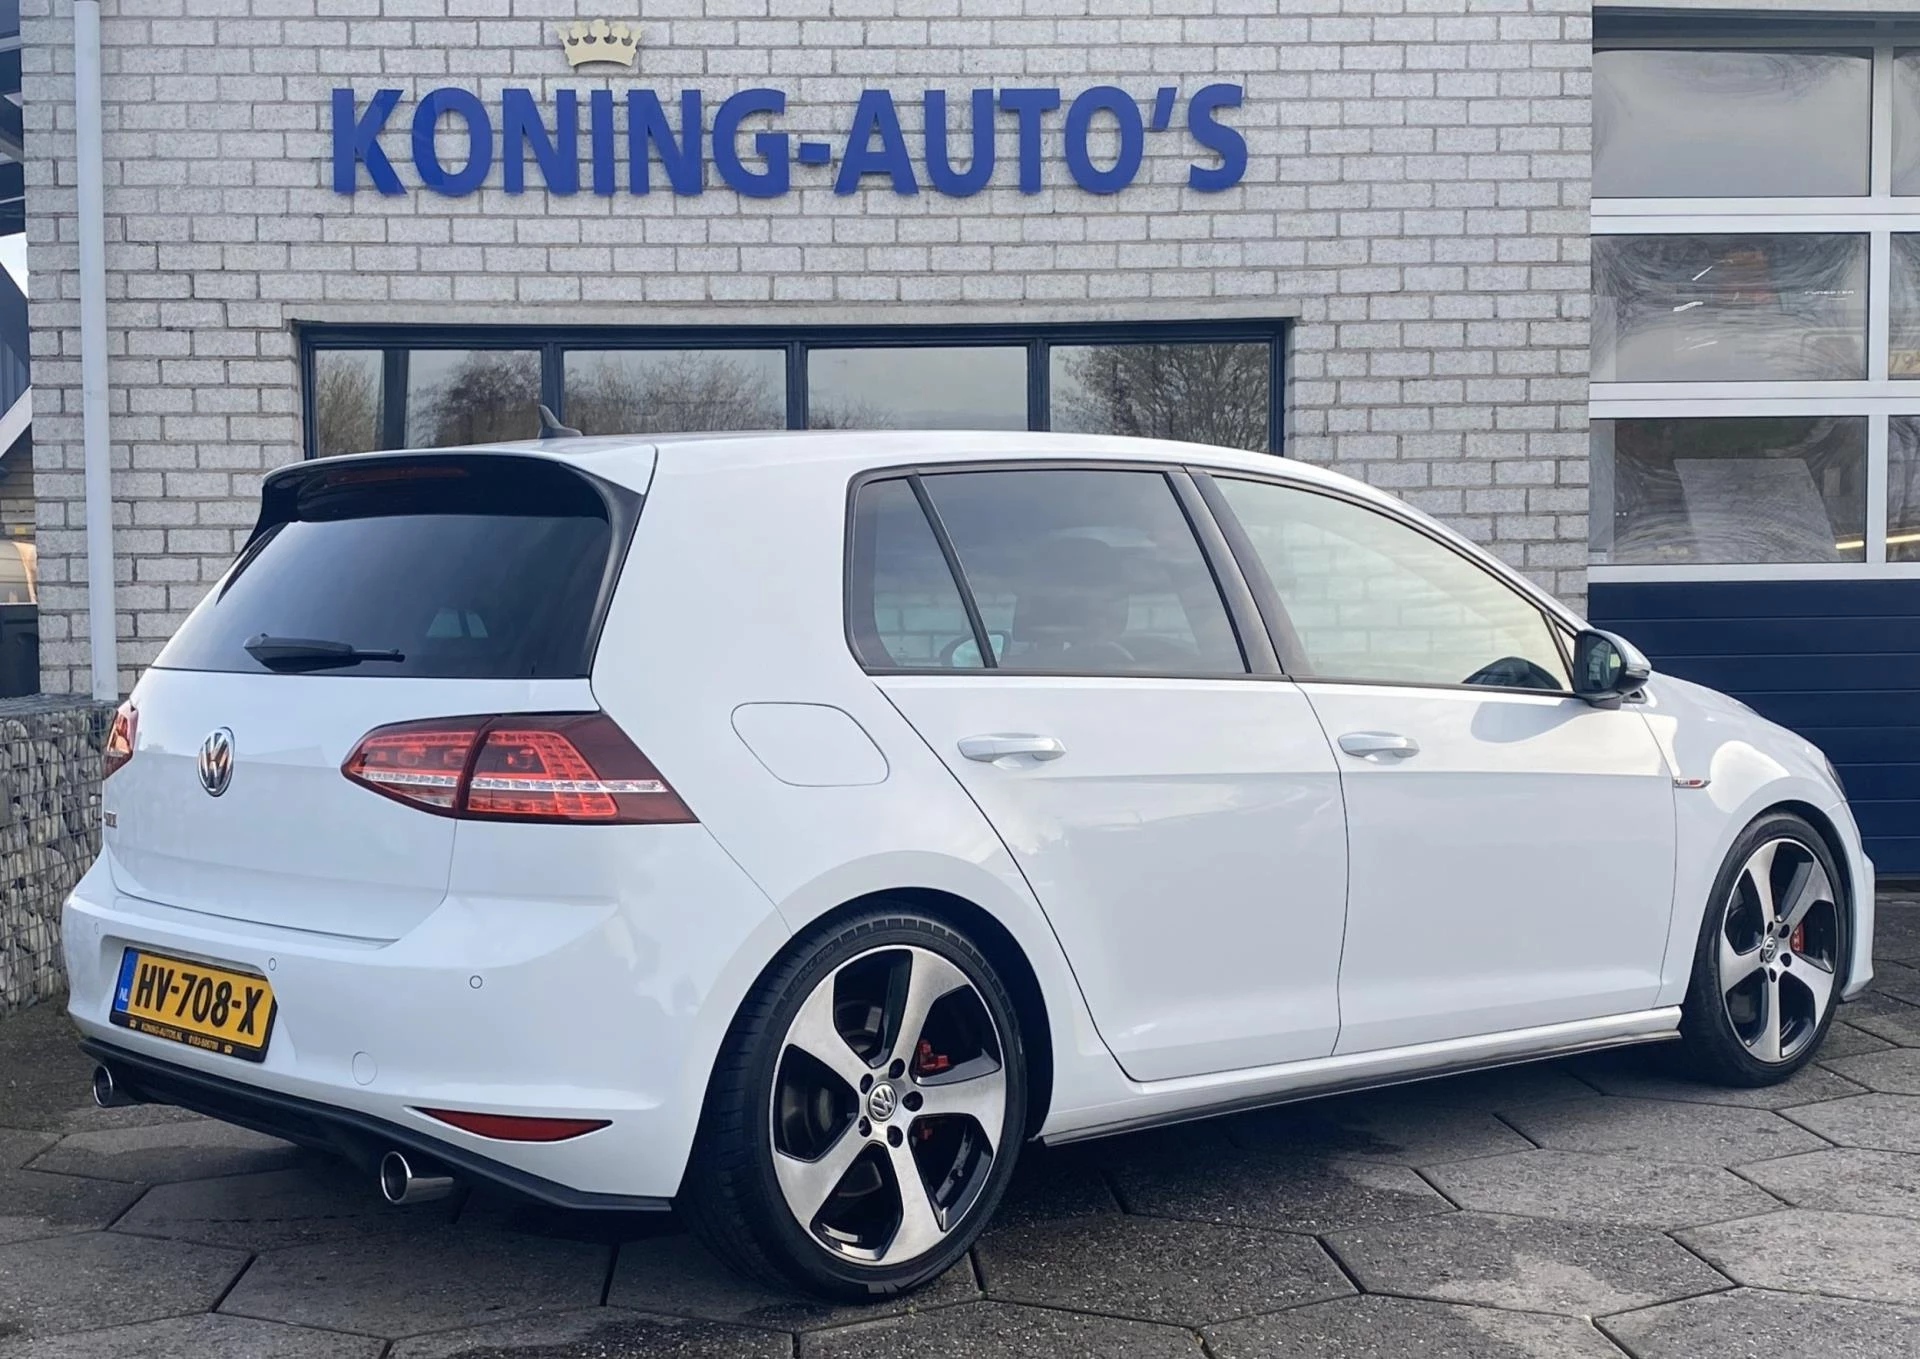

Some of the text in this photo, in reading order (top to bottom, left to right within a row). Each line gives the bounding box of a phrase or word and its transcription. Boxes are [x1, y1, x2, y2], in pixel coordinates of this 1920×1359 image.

[332, 83, 1248, 198] KONING-AUTO'S
[119, 987, 128, 1002] NL
[134, 963, 264, 1036] HV-708-X
